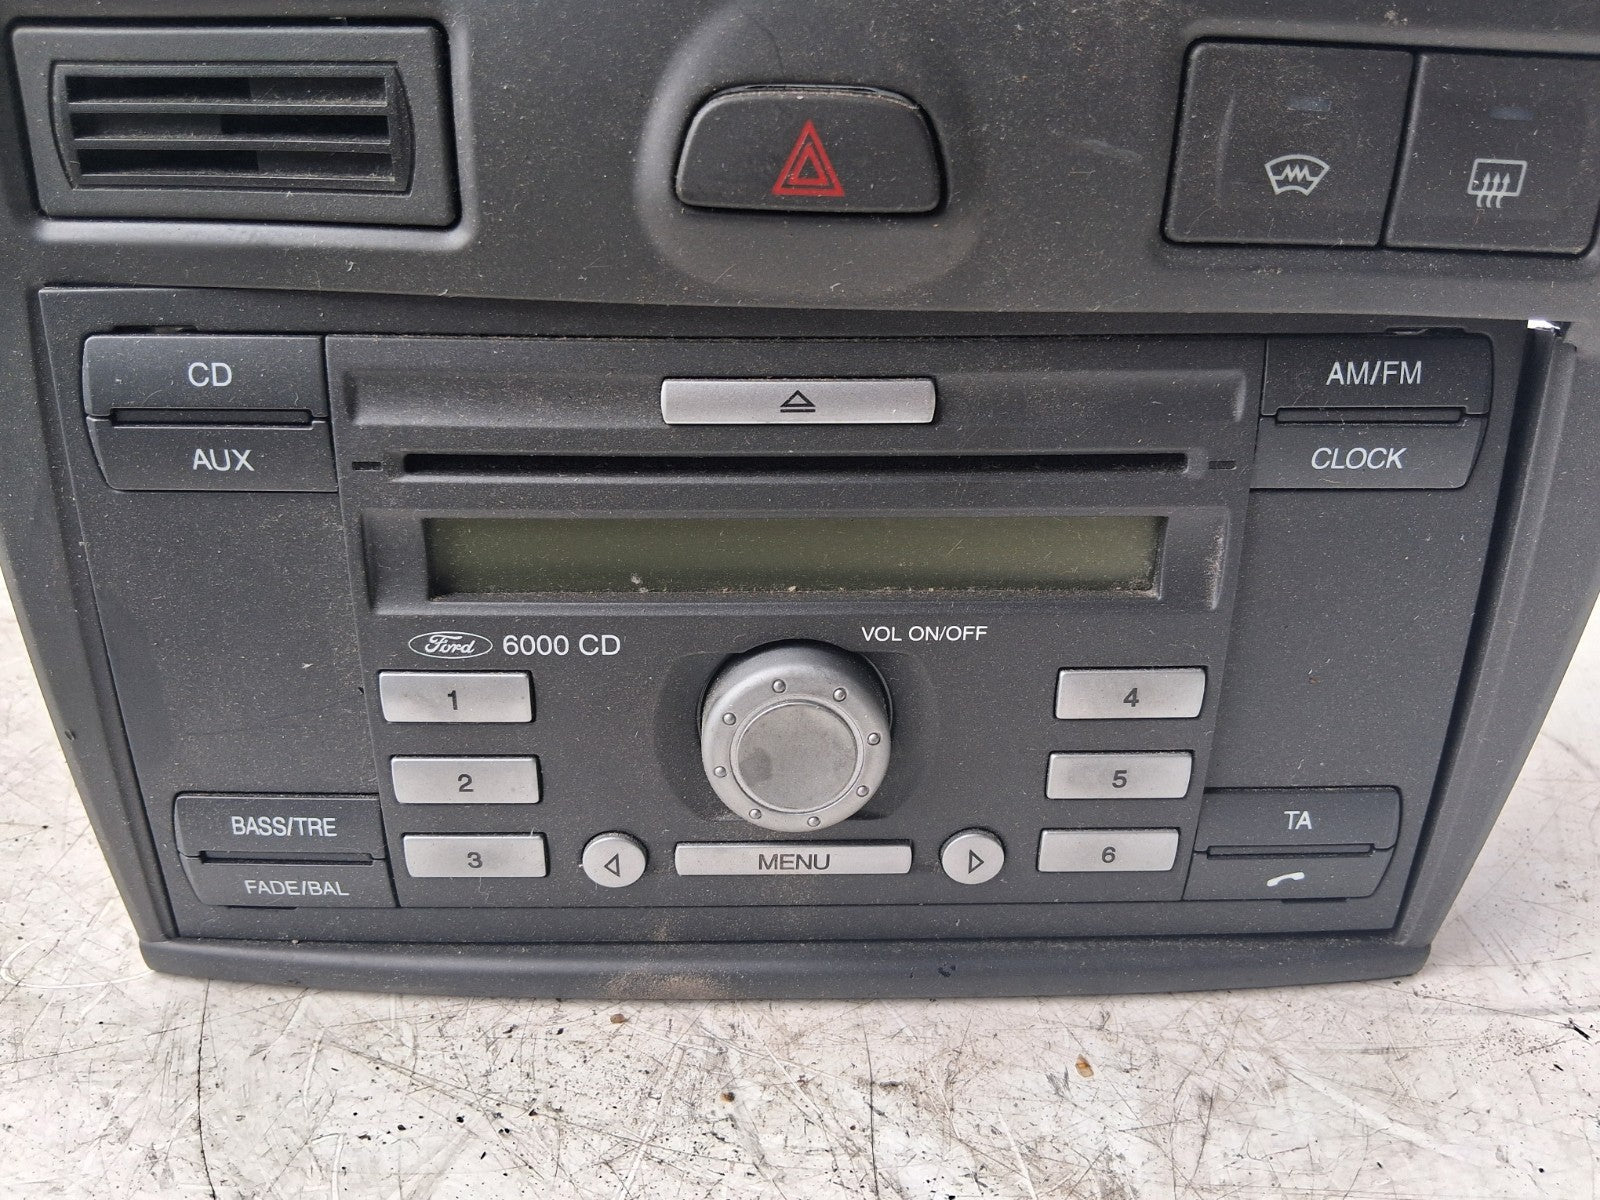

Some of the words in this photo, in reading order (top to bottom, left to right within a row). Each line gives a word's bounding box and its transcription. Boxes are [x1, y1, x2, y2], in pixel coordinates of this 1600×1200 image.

[188, 362, 233, 386] CD
[1326, 361, 1421, 385] AM/FM
[192, 449, 254, 472] AUX
[1312, 448, 1406, 469] CLOCK
[862, 626, 902, 641] VOL
[908, 626, 987, 641] ON/OFF
[424, 634, 476, 654] Ford
[503, 635, 569, 655] 6000
[579, 634, 620, 655] CD
[447, 691, 457, 709] 1
[1123, 688, 1139, 706] 4
[457, 774, 473, 792] 2
[1111, 770, 1127, 788] 5
[231, 816, 337, 837] BASS/TRE
[1284, 811, 1312, 829] TA
[467, 852, 482, 868] 3
[758, 853, 830, 871] MENU
[1101, 847, 1115, 863] 6
[245, 880, 349, 896] FADE/BAL
